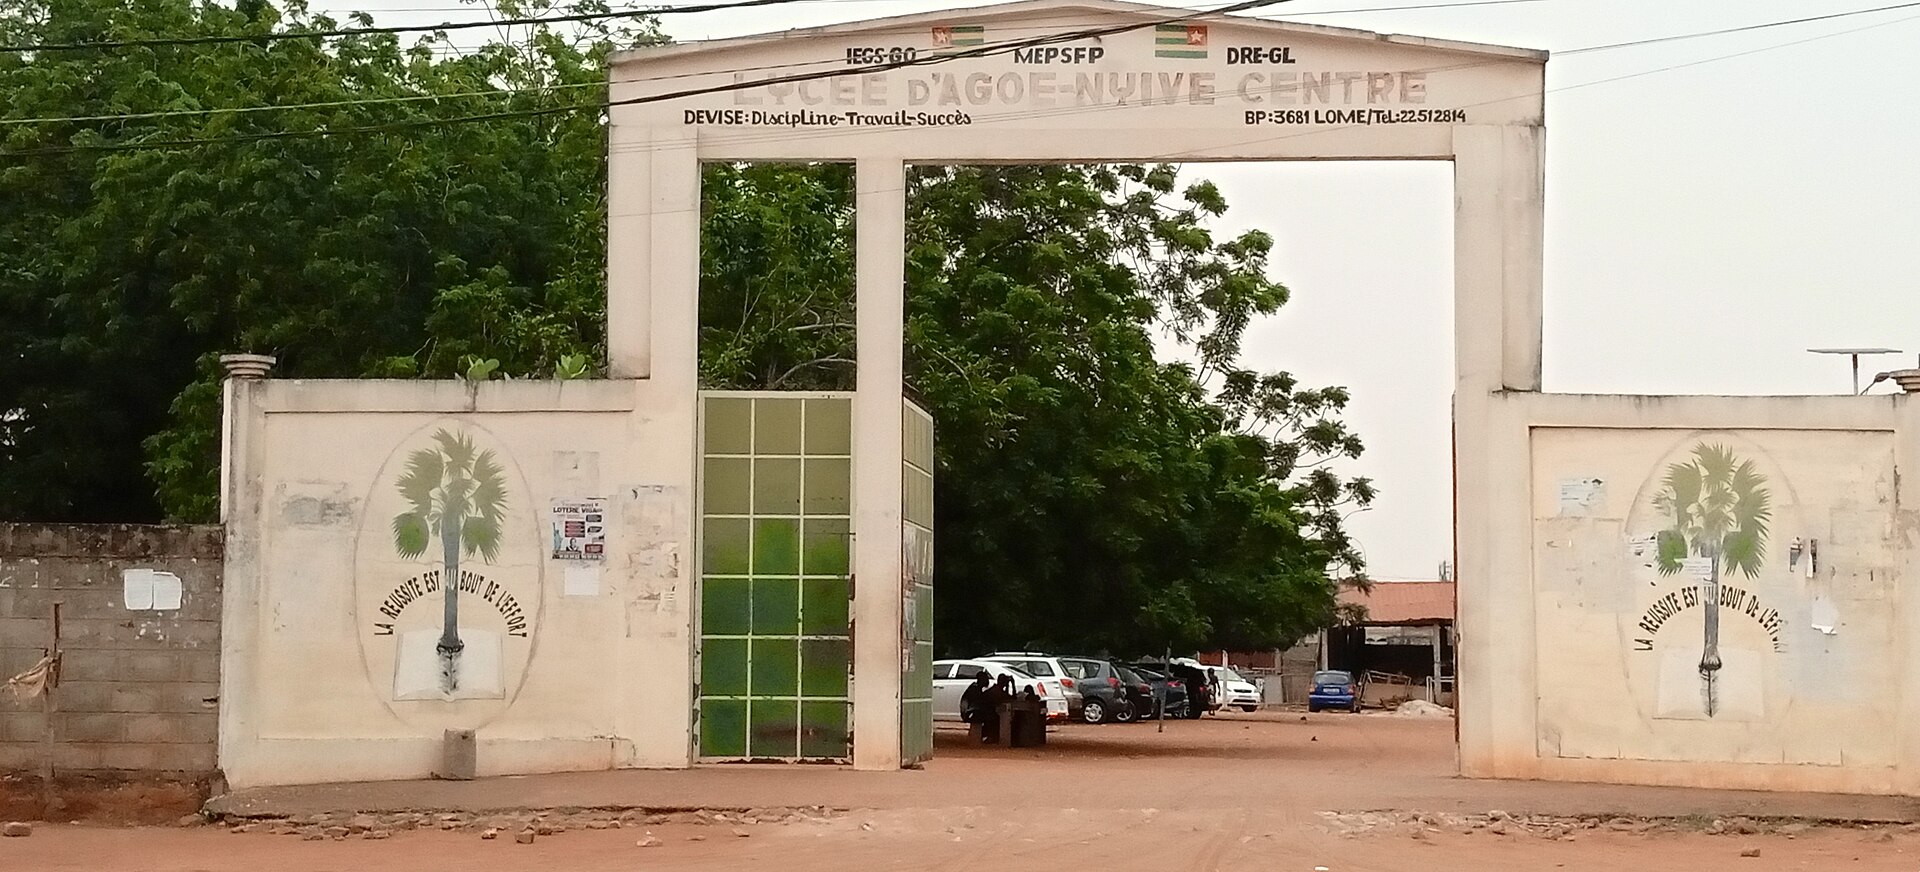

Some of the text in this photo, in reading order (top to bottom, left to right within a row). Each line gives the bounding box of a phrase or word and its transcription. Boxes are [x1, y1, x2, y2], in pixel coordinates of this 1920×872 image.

[1013, 47, 1104, 64] MEPSFP
[1227, 47, 1296, 65] DRE-GL
[733, 72, 888, 106] LYCEE
[1237, 71, 1427, 105] CENTRE
[423, 570, 440, 593] EST
[459, 570, 485, 595] BOUT
[483, 580, 500, 603] DE
[379, 577, 423, 620] REUSSITE
[1681, 586, 1699, 608] EST
[1719, 585, 1746, 611] BOUT
[1745, 595, 1759, 618] DE
[1638, 592, 1682, 635] REUSSITE
[374, 623, 394, 636] LA
[1634, 638, 1653, 651] LA
